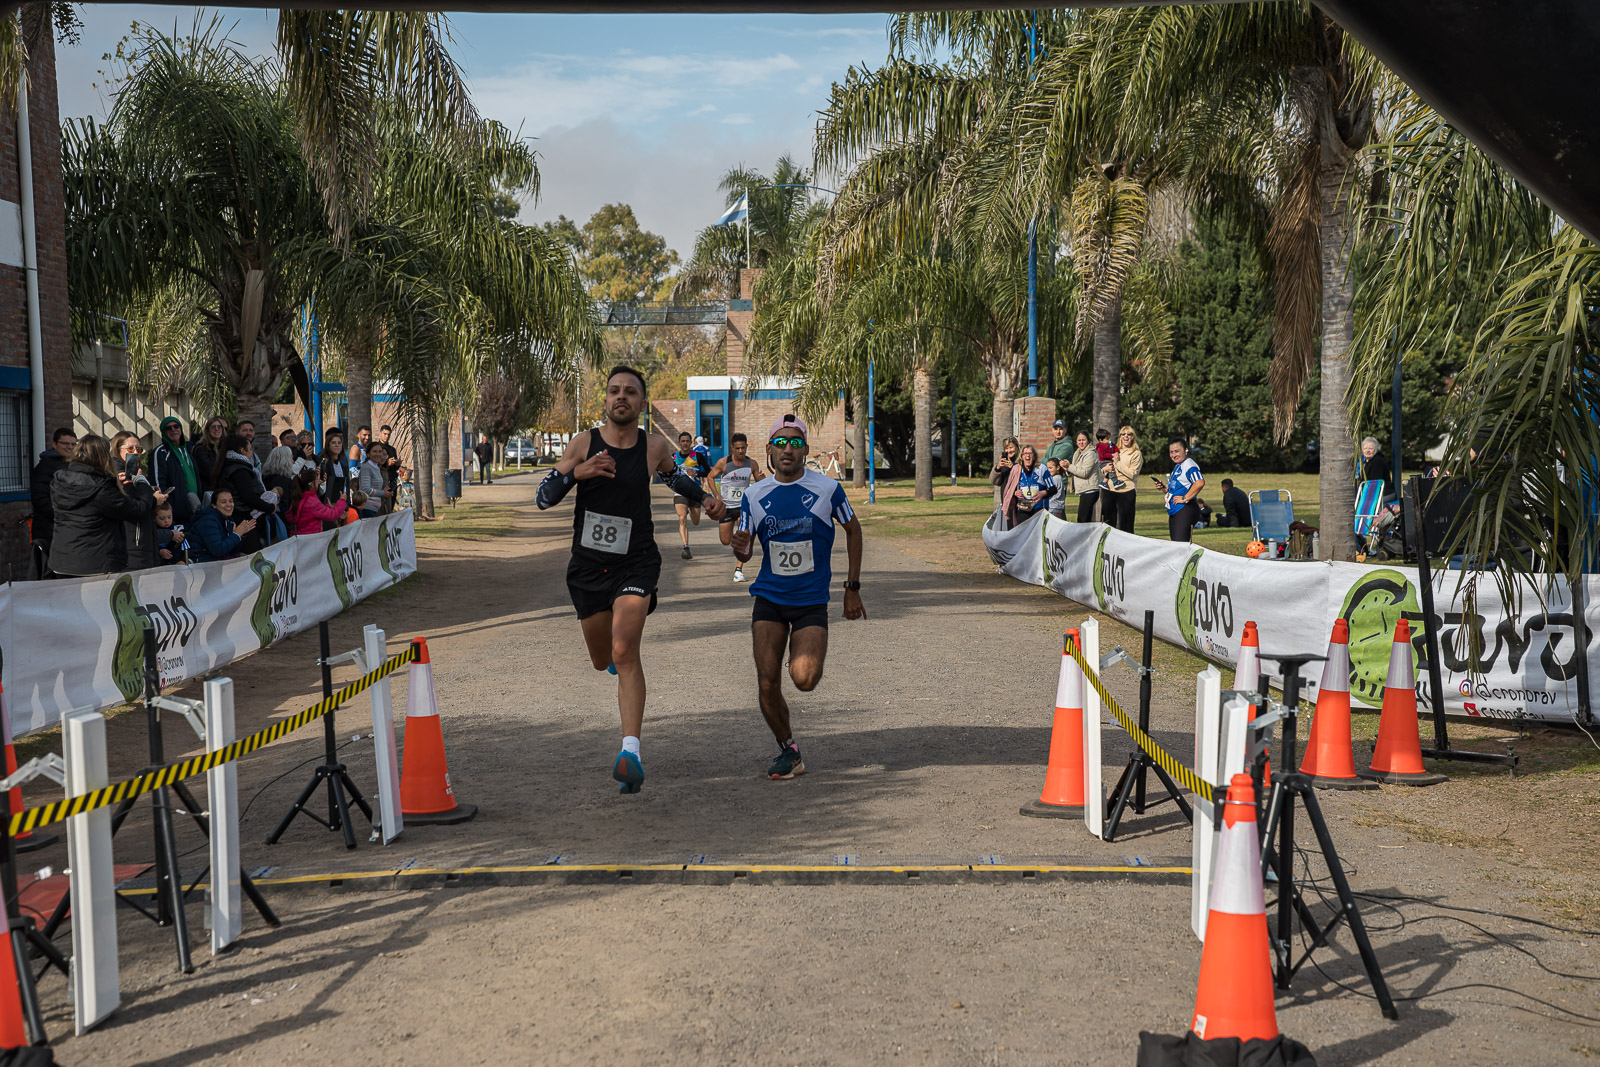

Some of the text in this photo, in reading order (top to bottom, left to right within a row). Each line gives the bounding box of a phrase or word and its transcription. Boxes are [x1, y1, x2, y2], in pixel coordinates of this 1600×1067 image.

[731, 490, 743, 498] 70
[592, 524, 618, 543] 88
[778, 551, 803, 568] 20
[1475, 683, 1557, 705] @cronorav
